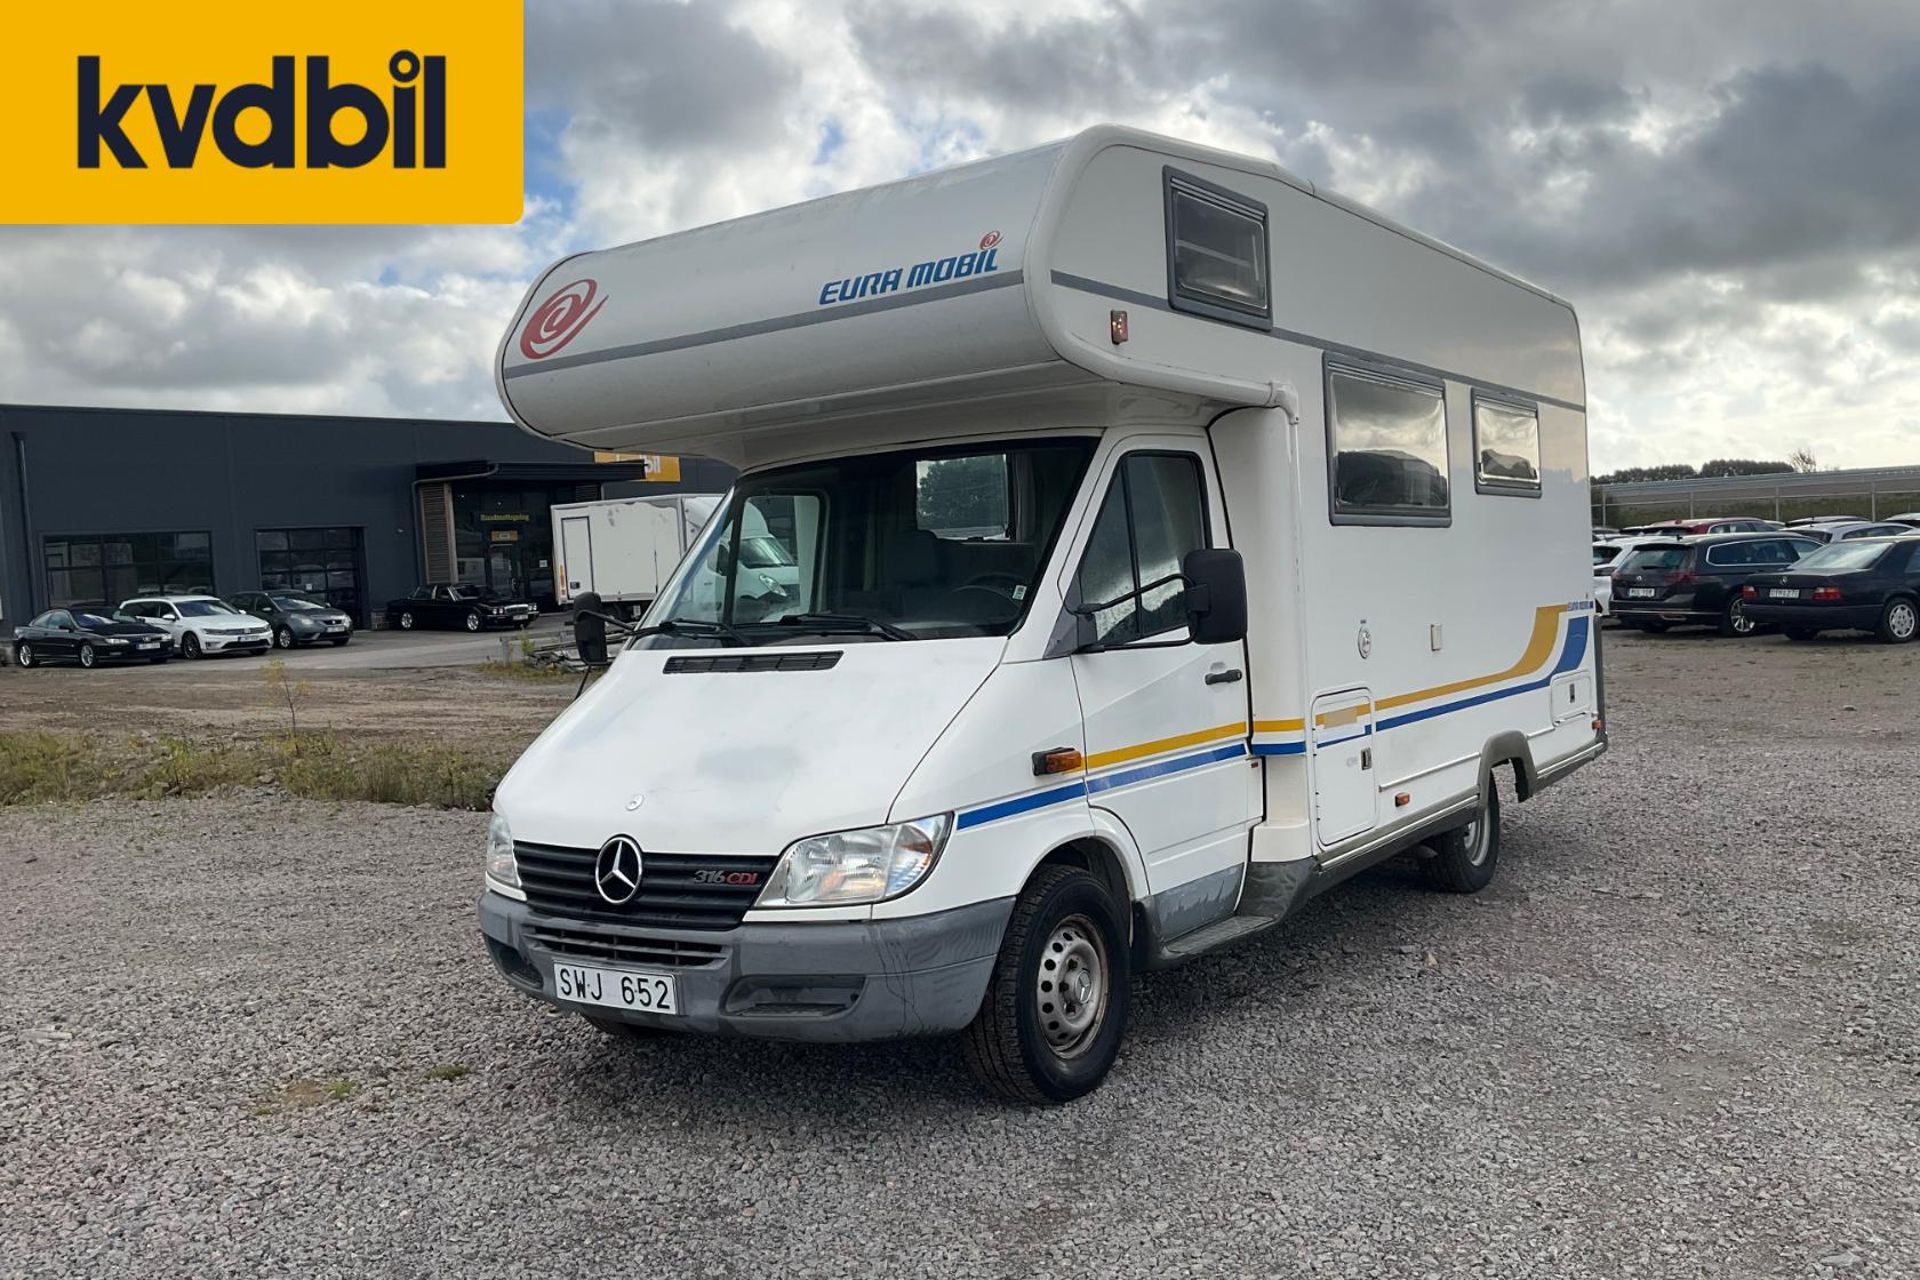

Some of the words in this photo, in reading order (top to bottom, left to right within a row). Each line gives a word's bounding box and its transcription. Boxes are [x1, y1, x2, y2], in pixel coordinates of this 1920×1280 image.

[818, 268, 903, 305] EURA
[906, 248, 999, 288] MOBIL
[559, 968, 602, 1001] SWJ
[621, 976, 670, 1010] 652
